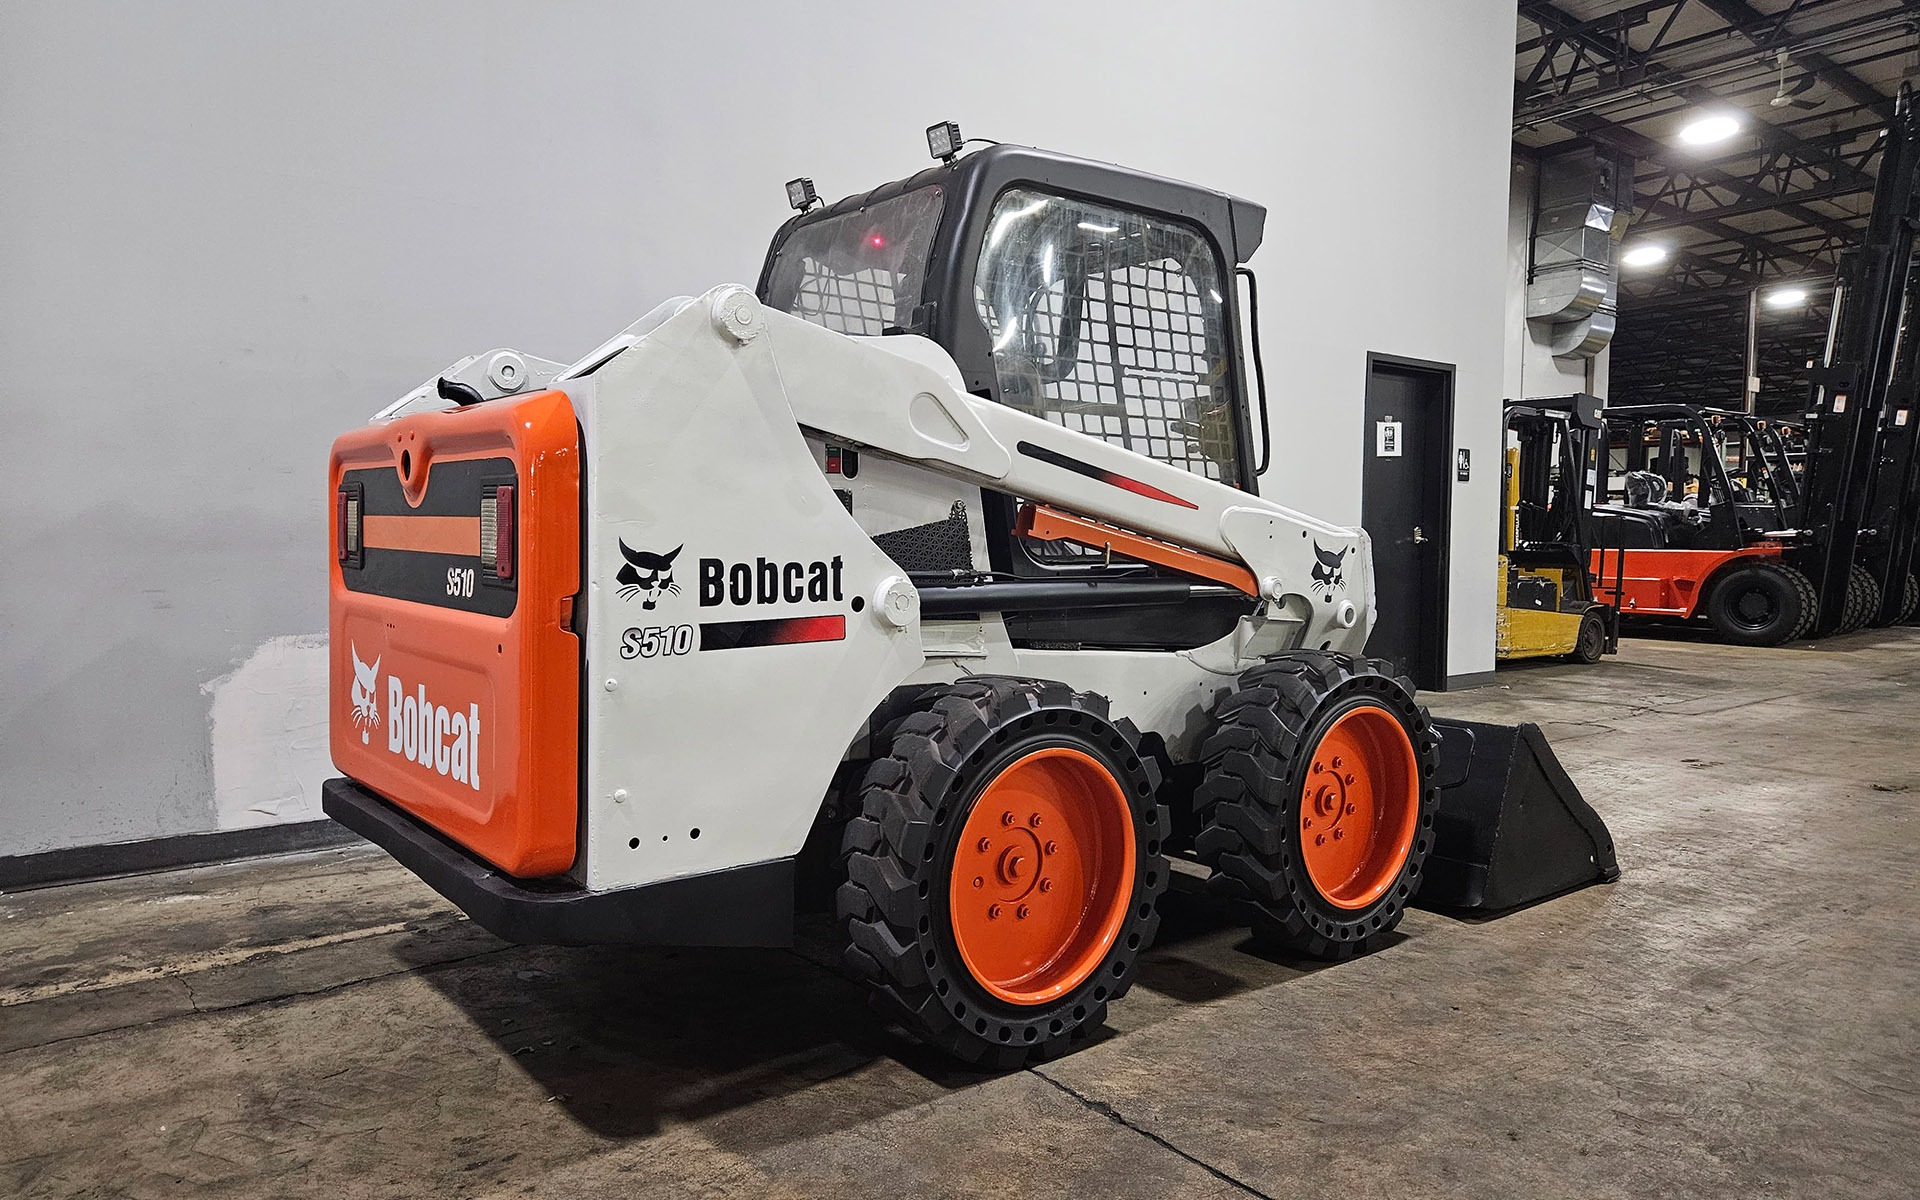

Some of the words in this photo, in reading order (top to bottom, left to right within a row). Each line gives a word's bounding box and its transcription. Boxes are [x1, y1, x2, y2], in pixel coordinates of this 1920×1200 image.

[446, 566, 475, 598] S510
[699, 555, 844, 607] Bobcat
[619, 624, 694, 660] S510
[388, 674, 480, 791] Bobcat
